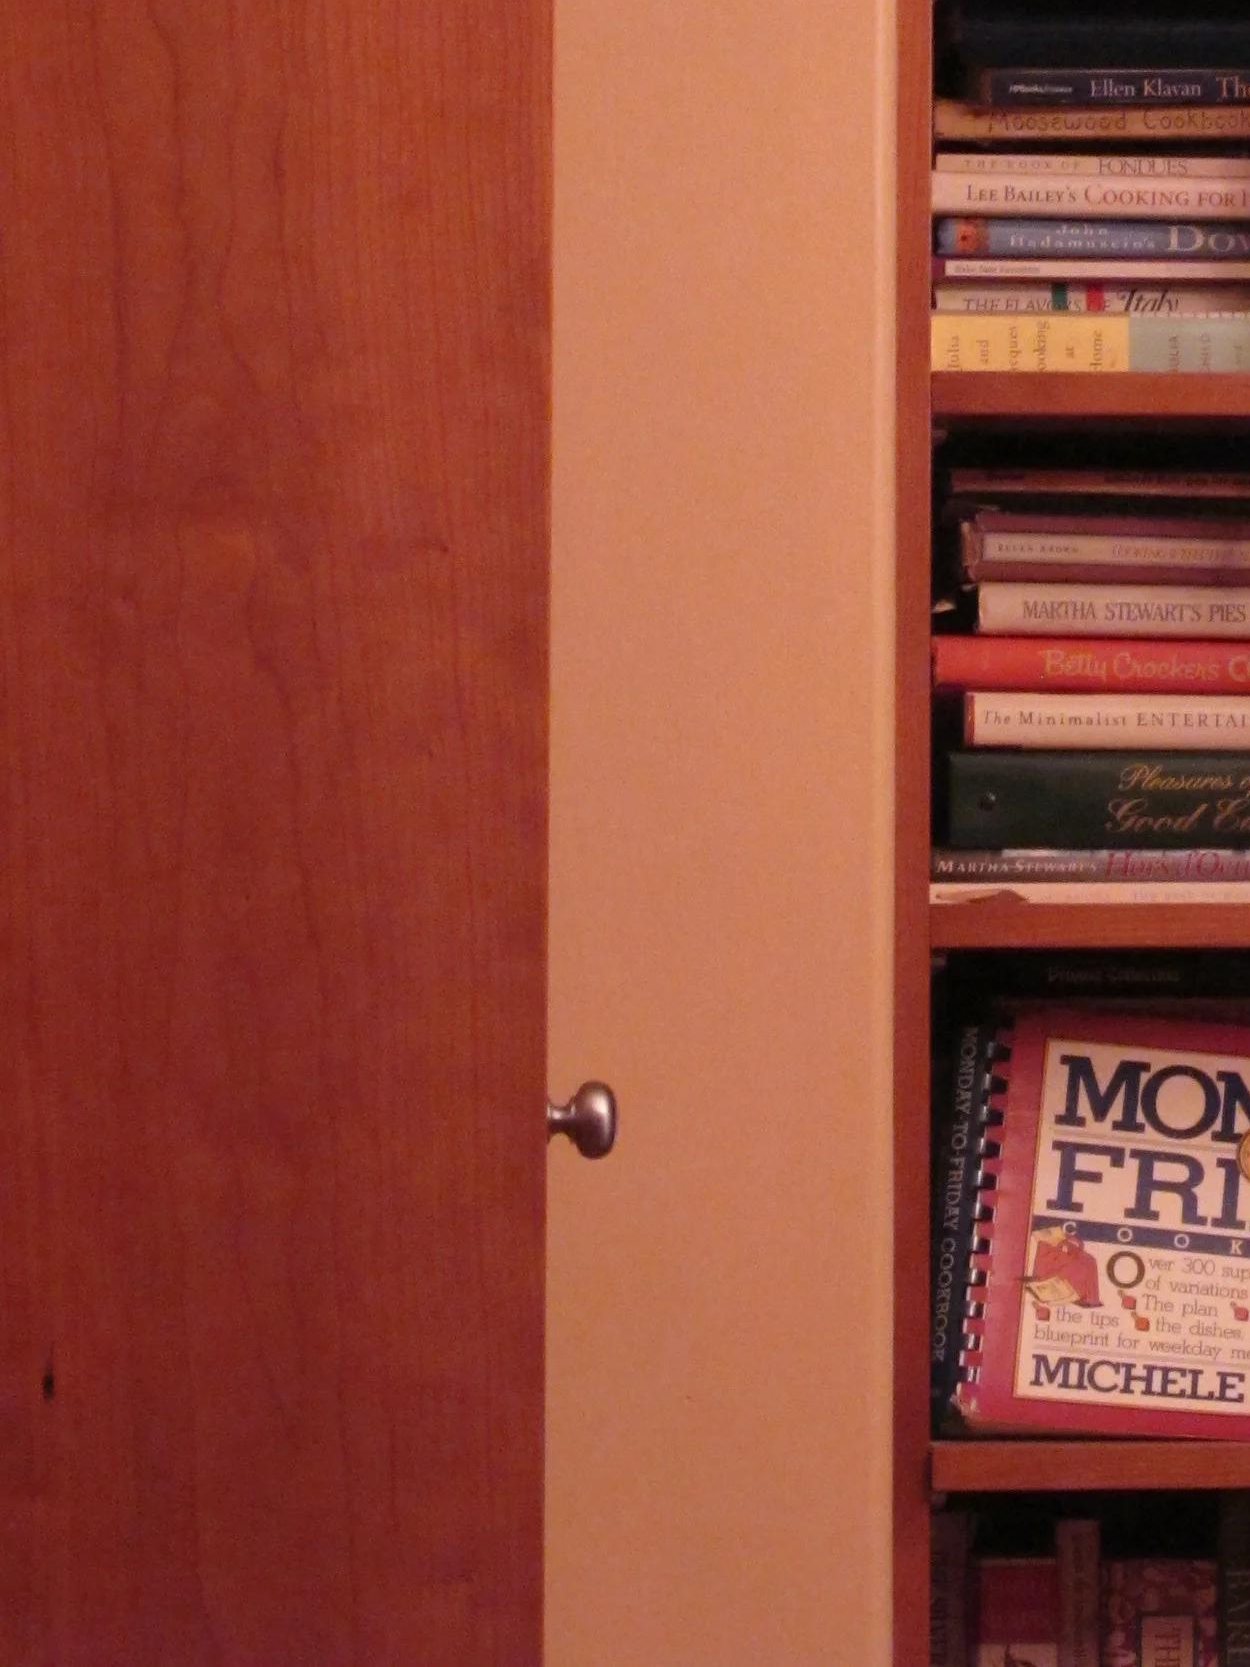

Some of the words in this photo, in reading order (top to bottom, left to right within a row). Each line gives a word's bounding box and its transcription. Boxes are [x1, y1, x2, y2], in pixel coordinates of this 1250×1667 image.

[1090, 78, 1136, 98] Ellen
[1143, 78, 1202, 98] Klavan
[987, 109, 1127, 133] Moosewood
[1098, 157, 1188, 175] FONDUES
[966, 184, 998, 203] LEE
[1004, 184, 1077, 204] BAILEY'S
[1084, 183, 1189, 206] COOKING
[1197, 191, 1236, 207] FOR
[963, 297, 1000, 313] THE
[976, 338, 990, 365] and
[1032, 320, 1050, 371] ooking
[1022, 600, 1097, 621] MARTHA
[1103, 602, 1201, 623] STEWART'S
[1208, 603, 1246, 624] PIES
[1038, 648, 1108, 683] Betty
[1112, 651, 1221, 682] Crocker's
[982, 709, 1011, 726] The
[1018, 710, 1127, 727] Minimalist
[1117, 763, 1234, 792] Pleasures
[1103, 797, 1208, 833] Good
[936, 858, 1009, 874] MARTHA
[1181, 1257, 1216, 1276] 300
[932, 1236, 959, 1363] COOKBOOK
[1145, 1274, 1162, 1290] of
[1168, 1279, 1248, 1300] variations
[1142, 1293, 1174, 1313] The
[1181, 1300, 1219, 1321] plan
[1055, 1308, 1082, 1324] the
[1089, 1311, 1120, 1332] tips
[1154, 1319, 1182, 1336] the
[1034, 1323, 1109, 1348] blueprint
[1116, 1331, 1140, 1349] for
[1149, 1338, 1222, 1361] weekday
[1029, 1353, 1246, 1404] MICHELE
